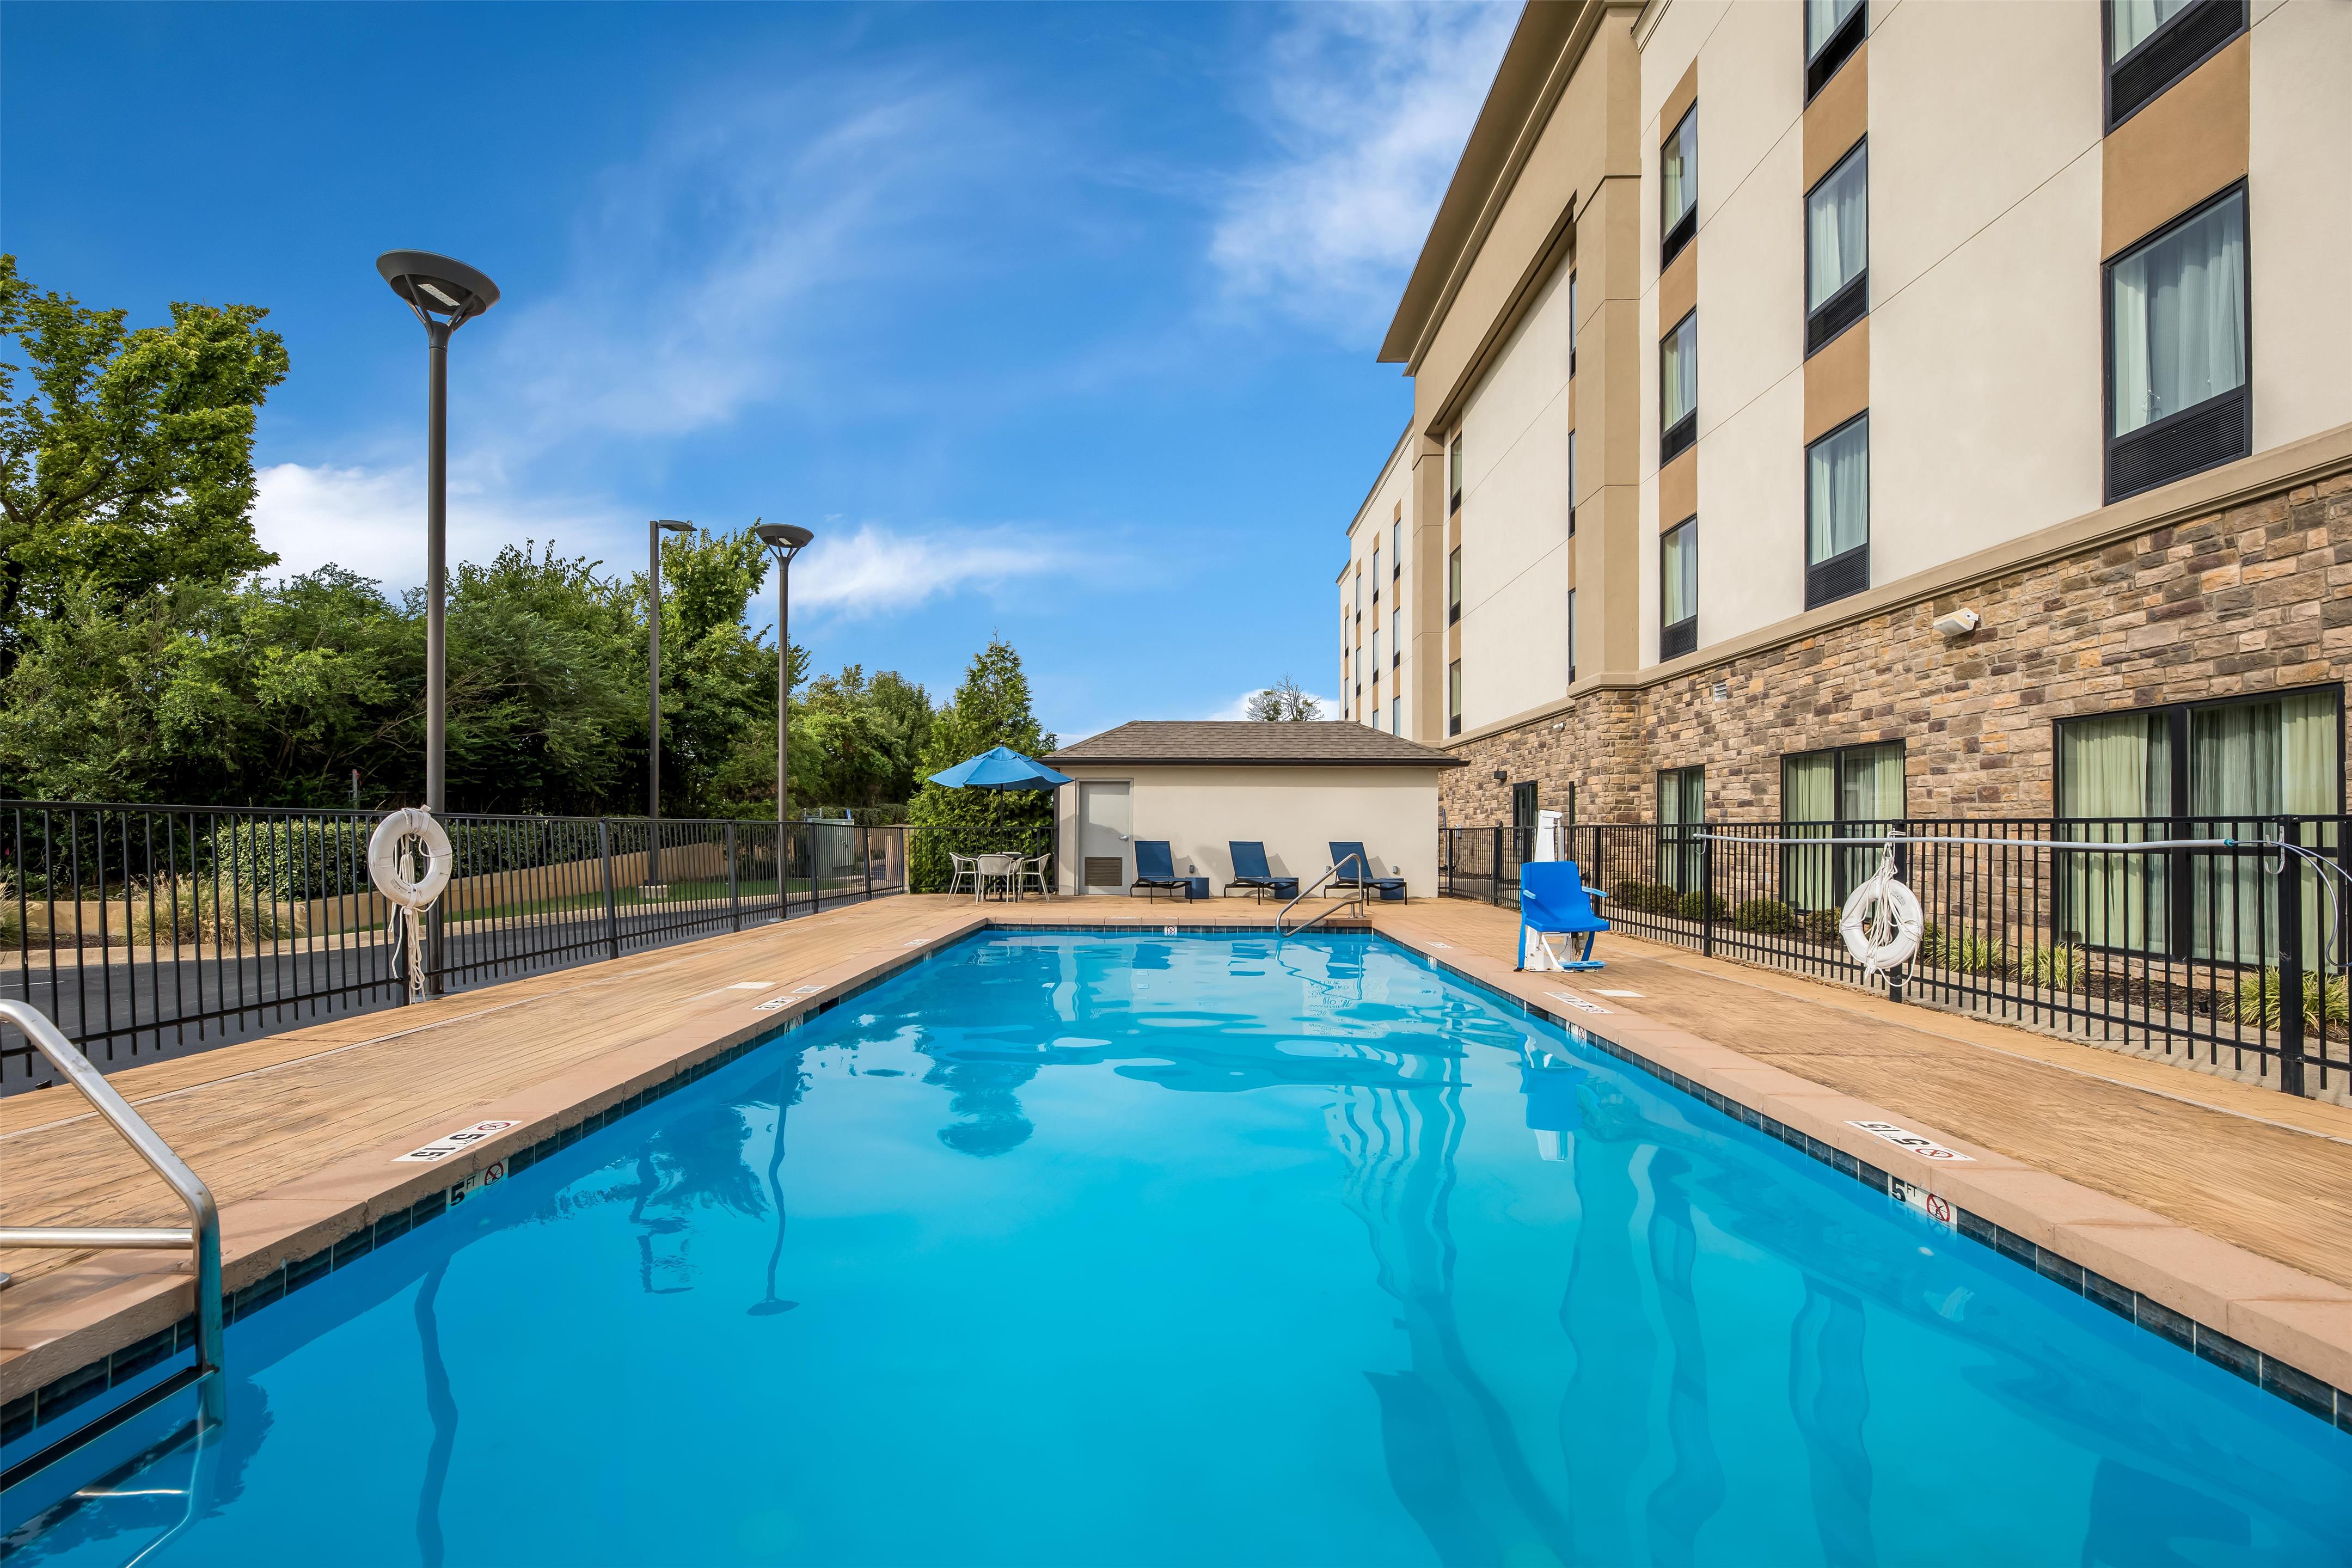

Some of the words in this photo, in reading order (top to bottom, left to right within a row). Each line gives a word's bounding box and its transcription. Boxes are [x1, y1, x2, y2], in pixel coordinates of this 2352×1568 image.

[1891, 1138, 1931, 1146] 5
[450, 1180, 465, 1206] 5
[465, 1175, 476, 1190] FT
[1891, 1177, 1906, 1202] 5
[1907, 1183, 1918, 1198] FT
